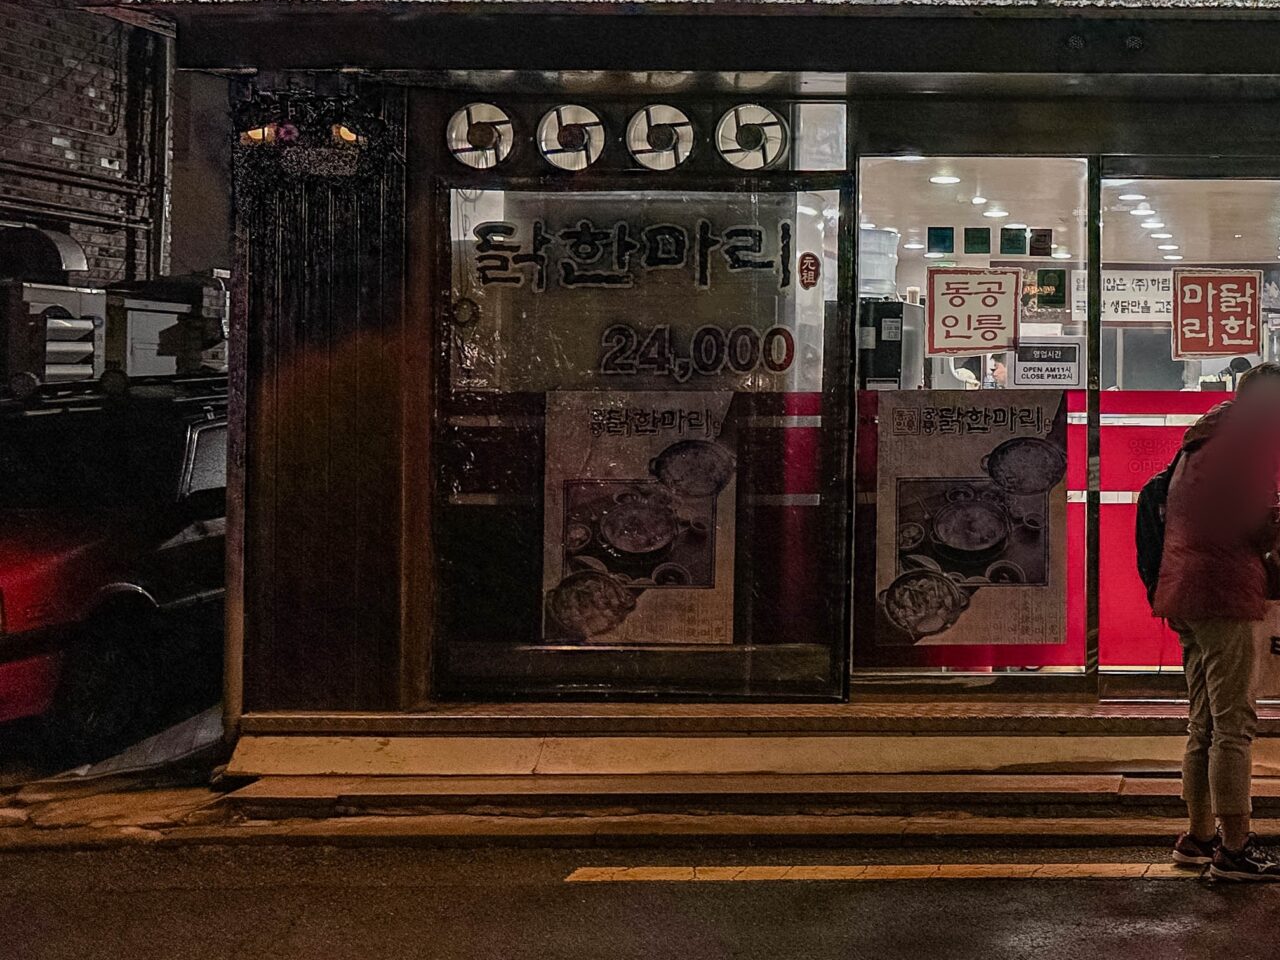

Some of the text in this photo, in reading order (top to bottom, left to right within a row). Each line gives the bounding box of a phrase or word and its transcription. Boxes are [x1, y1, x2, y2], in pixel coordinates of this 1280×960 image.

[472, 219, 793, 292] 닭한마리
[601, 324, 796, 381] 24,000
[938, 405, 1042, 435] 닭한마리
